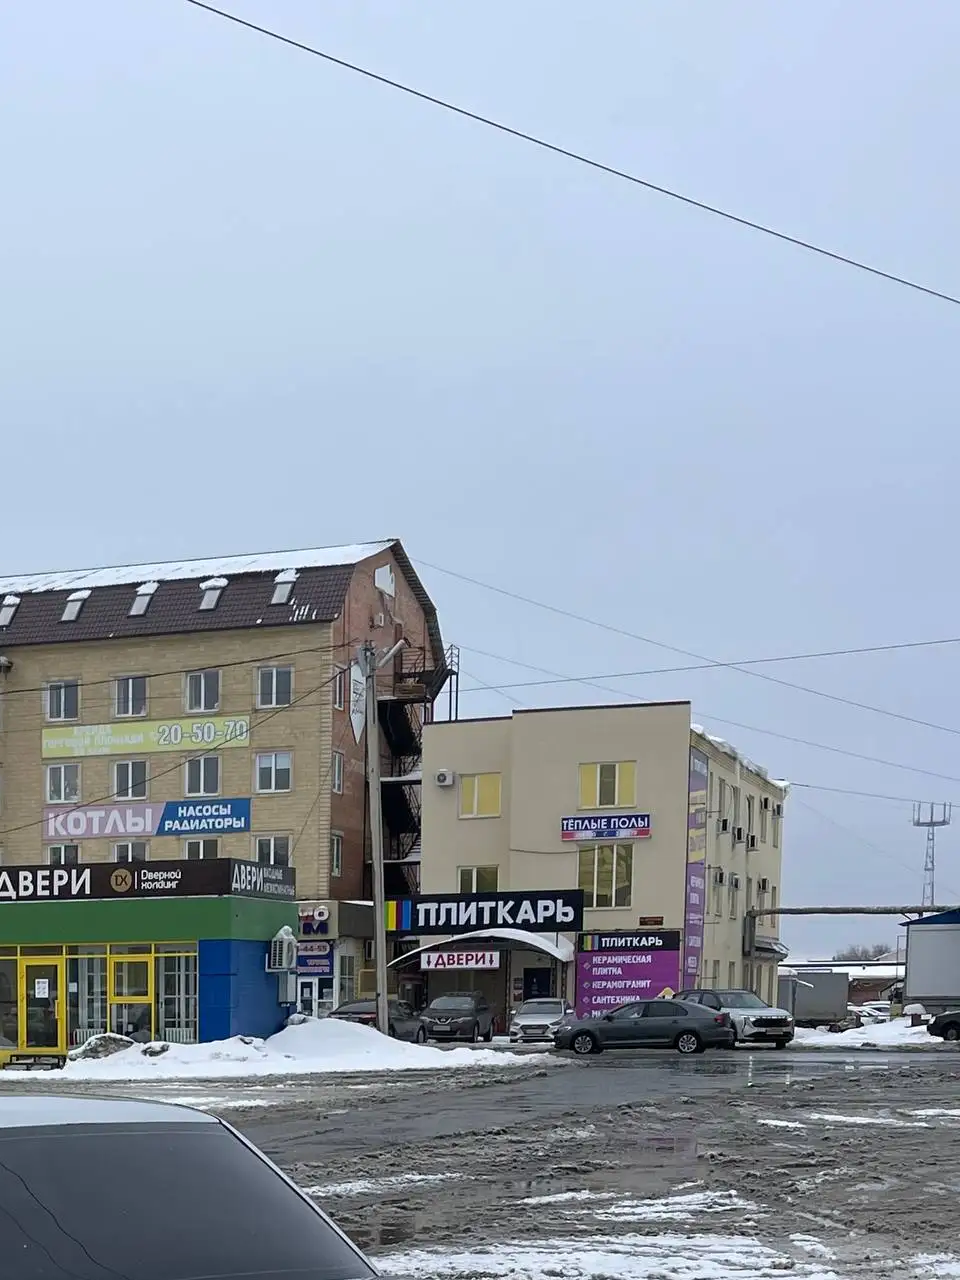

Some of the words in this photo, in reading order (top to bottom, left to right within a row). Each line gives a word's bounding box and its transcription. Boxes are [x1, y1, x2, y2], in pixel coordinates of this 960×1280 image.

[158, 720, 247, 745] 20-50-70
[178, 804, 231, 817] НАСОСЫ
[48, 808, 152, 836] КОТЛЫ
[165, 817, 245, 831] РАДИАТОРЫ
[562, 818, 608, 831] ТЁПЛЫЕ
[611, 816, 648, 828] ПОЛЫ
[232, 863, 264, 892] ДВЕРИ
[416, 899, 575, 926] ПЛИТКАРЬ
[601, 937, 663, 948] ПЛИТКАРЬ
[435, 952, 486, 968] ДВЕРИ
[592, 955, 652, 964] КЕРАМИЧЕСКАЯ
[592, 967, 622, 975] ПЛИТКА
[592, 980, 652, 989] КЕРАМОГРАНИТ
[592, 995, 641, 1004] САНТЕХНИКА
